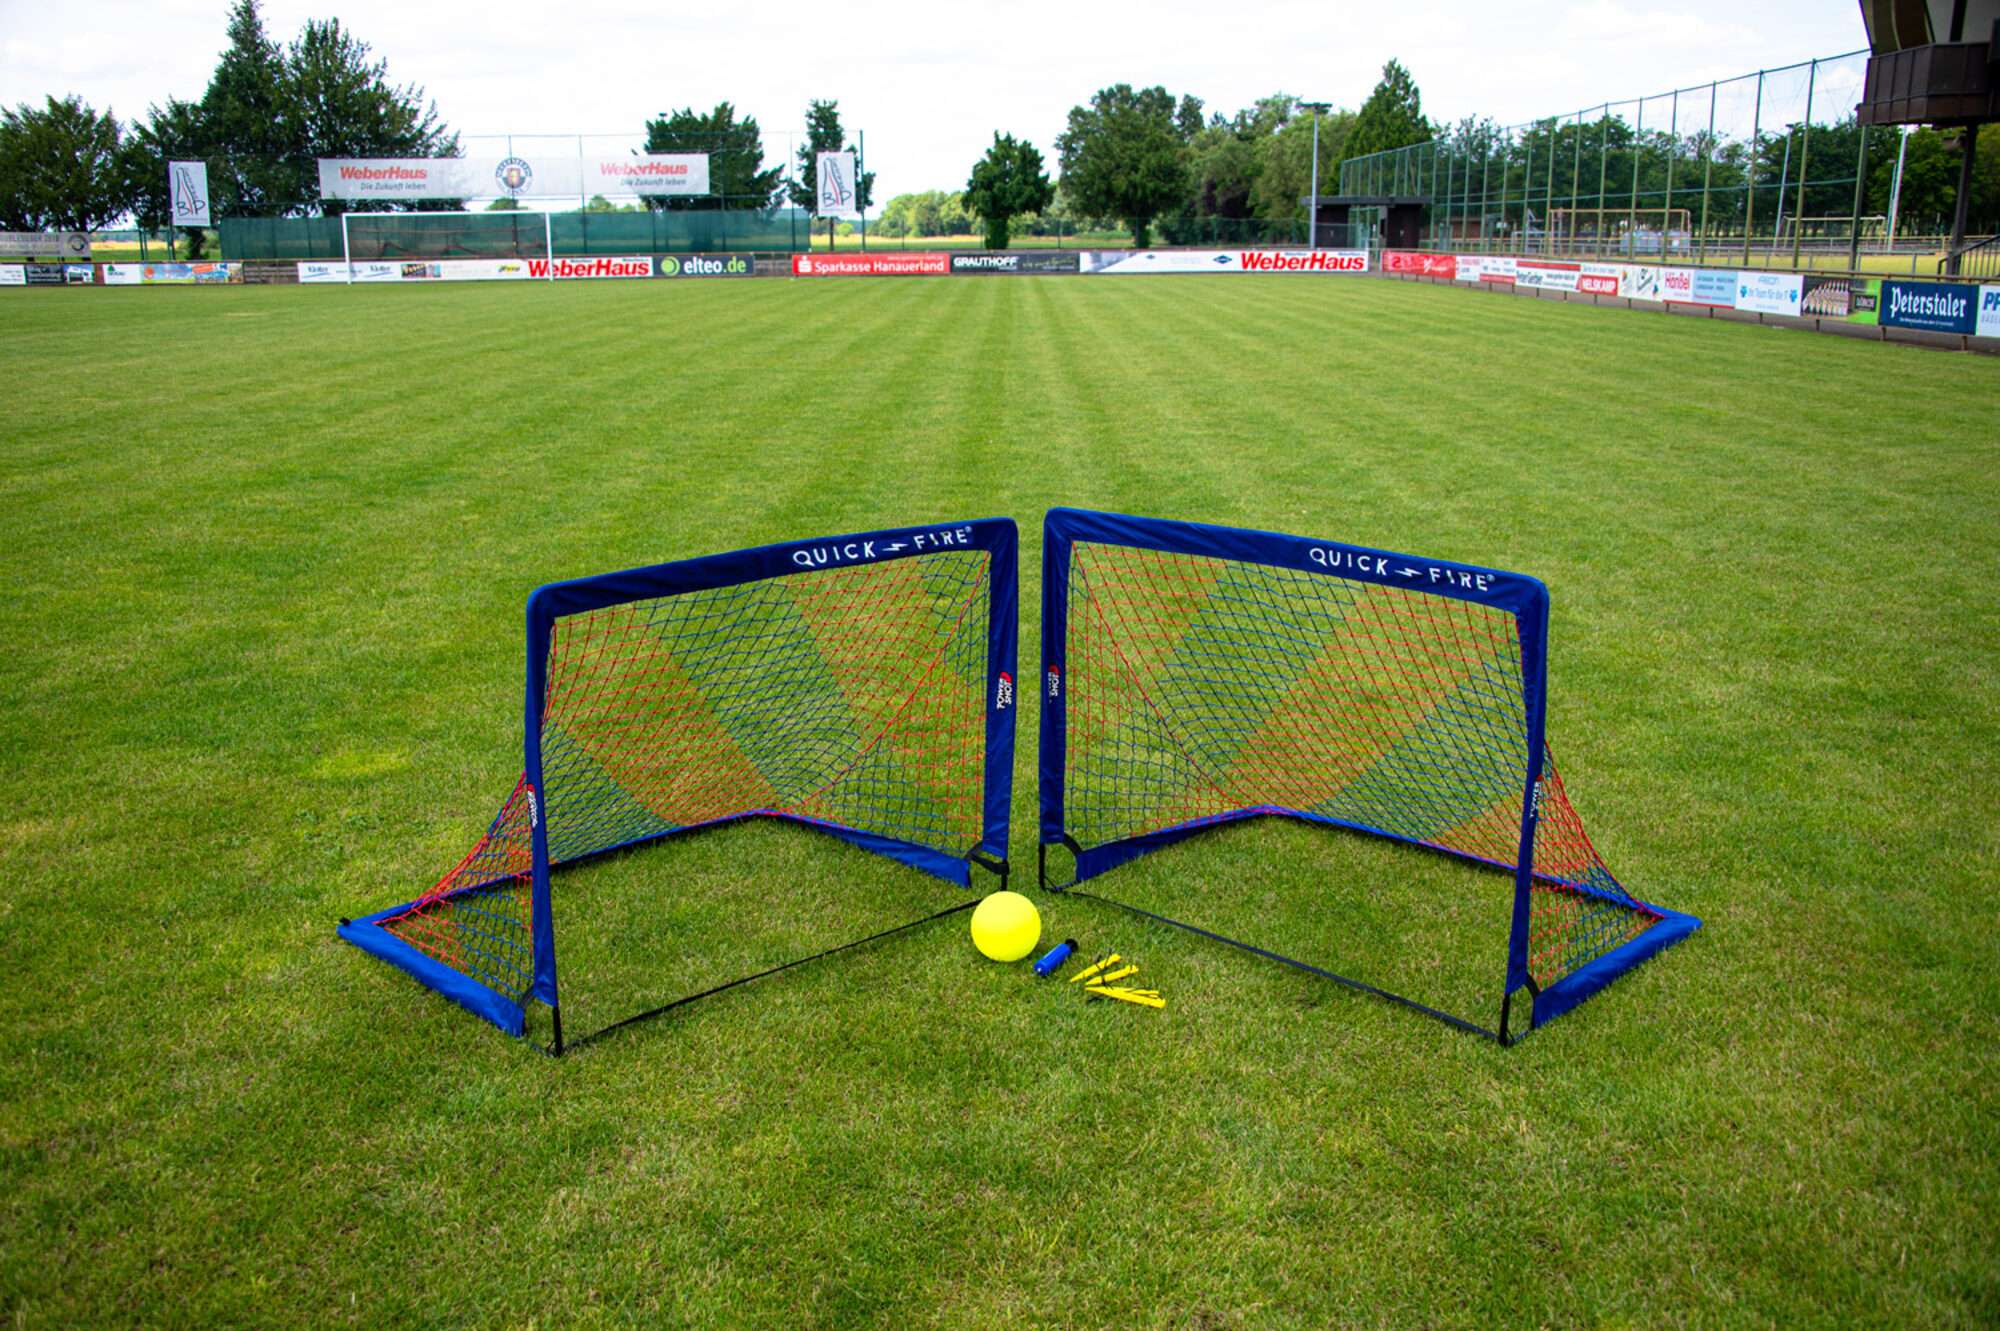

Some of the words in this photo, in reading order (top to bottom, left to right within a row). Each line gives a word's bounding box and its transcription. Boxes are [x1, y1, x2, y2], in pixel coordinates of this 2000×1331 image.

[340, 166, 427, 179] WeberHaus
[600, 161, 688, 175] WeberHaus
[375, 182, 403, 191] Zukunft
[405, 182, 426, 190] leben
[528, 259, 649, 277] WeberHaus
[683, 256, 746, 273] elteo.de
[815, 261, 871, 273] Sparkasse
[873, 259, 944, 271] Hanauerland
[954, 256, 1018, 267] GRAUTHOFF
[1241, 252, 1365, 269] WeberHaus
[1890, 286, 1967, 318] Peterstaler
[793, 541, 876, 567] QUICK
[1309, 548, 1389, 576] QUICK
